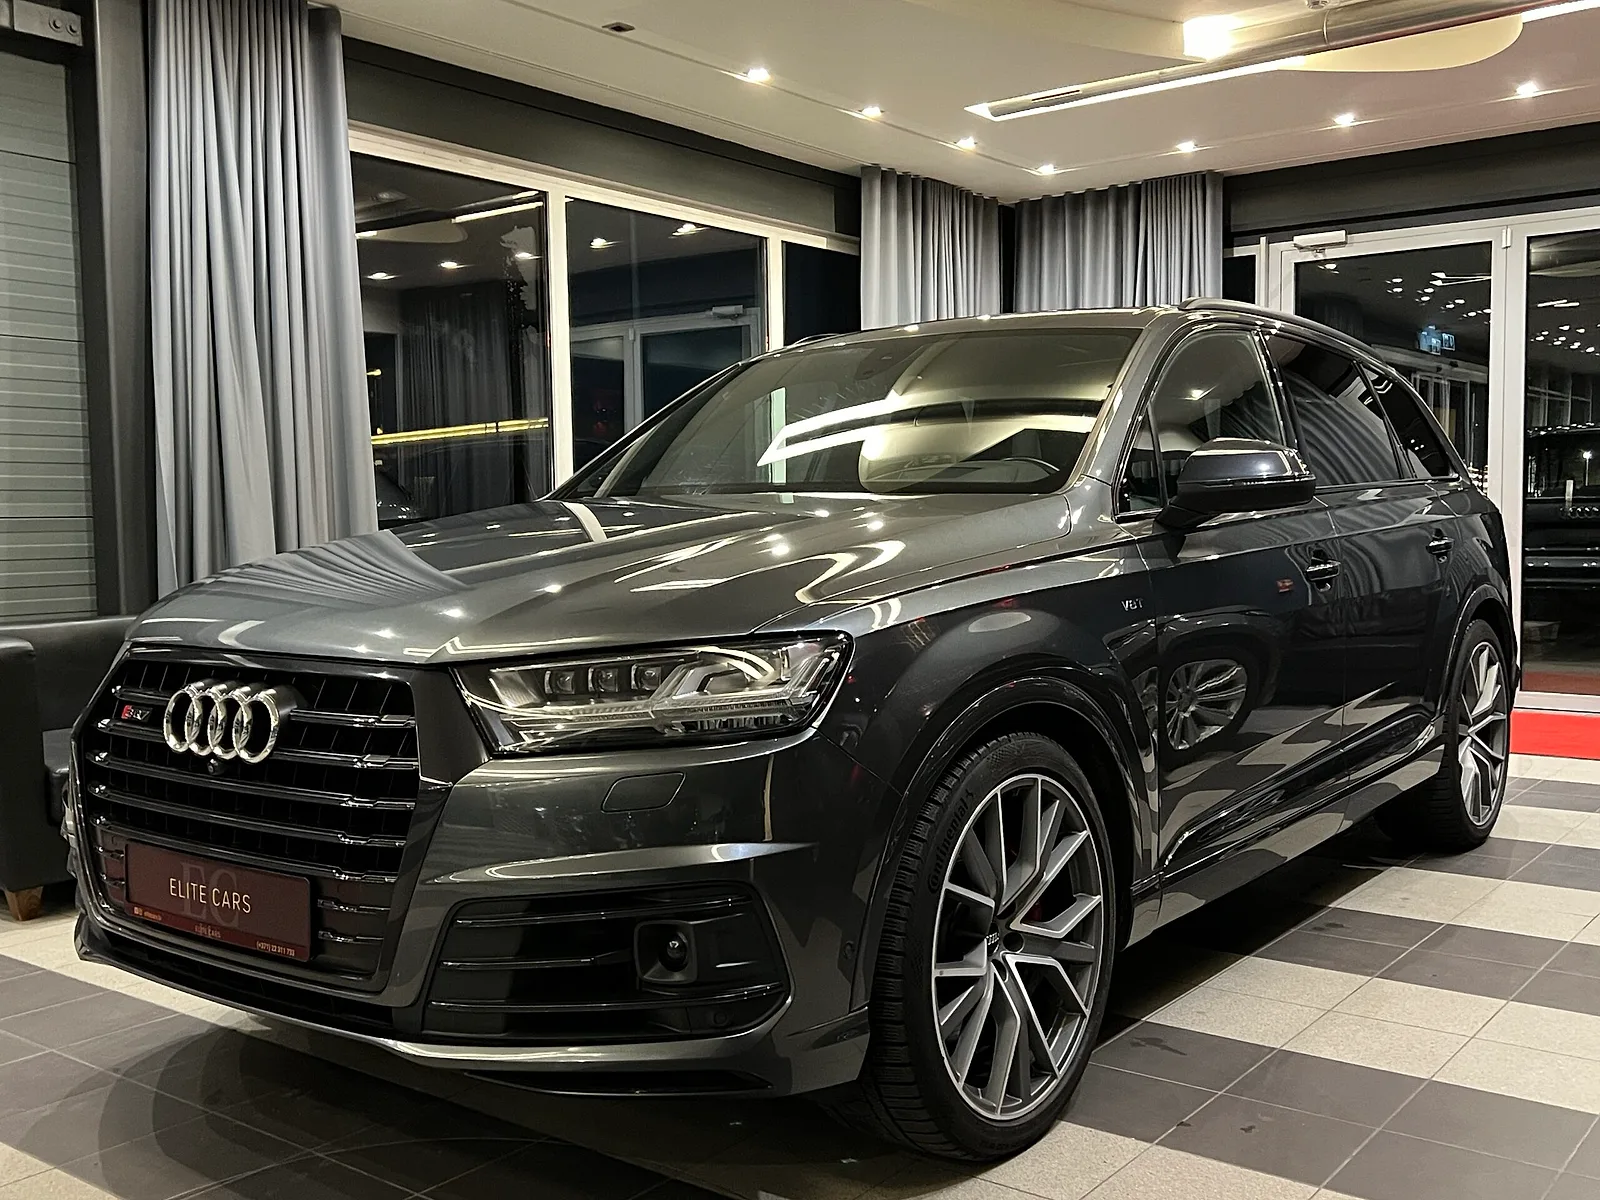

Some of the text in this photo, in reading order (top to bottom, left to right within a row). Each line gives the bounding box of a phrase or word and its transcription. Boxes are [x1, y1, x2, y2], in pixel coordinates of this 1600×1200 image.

[928, 797, 969, 893] Continental
[169, 877, 252, 914] ELITE CARS
